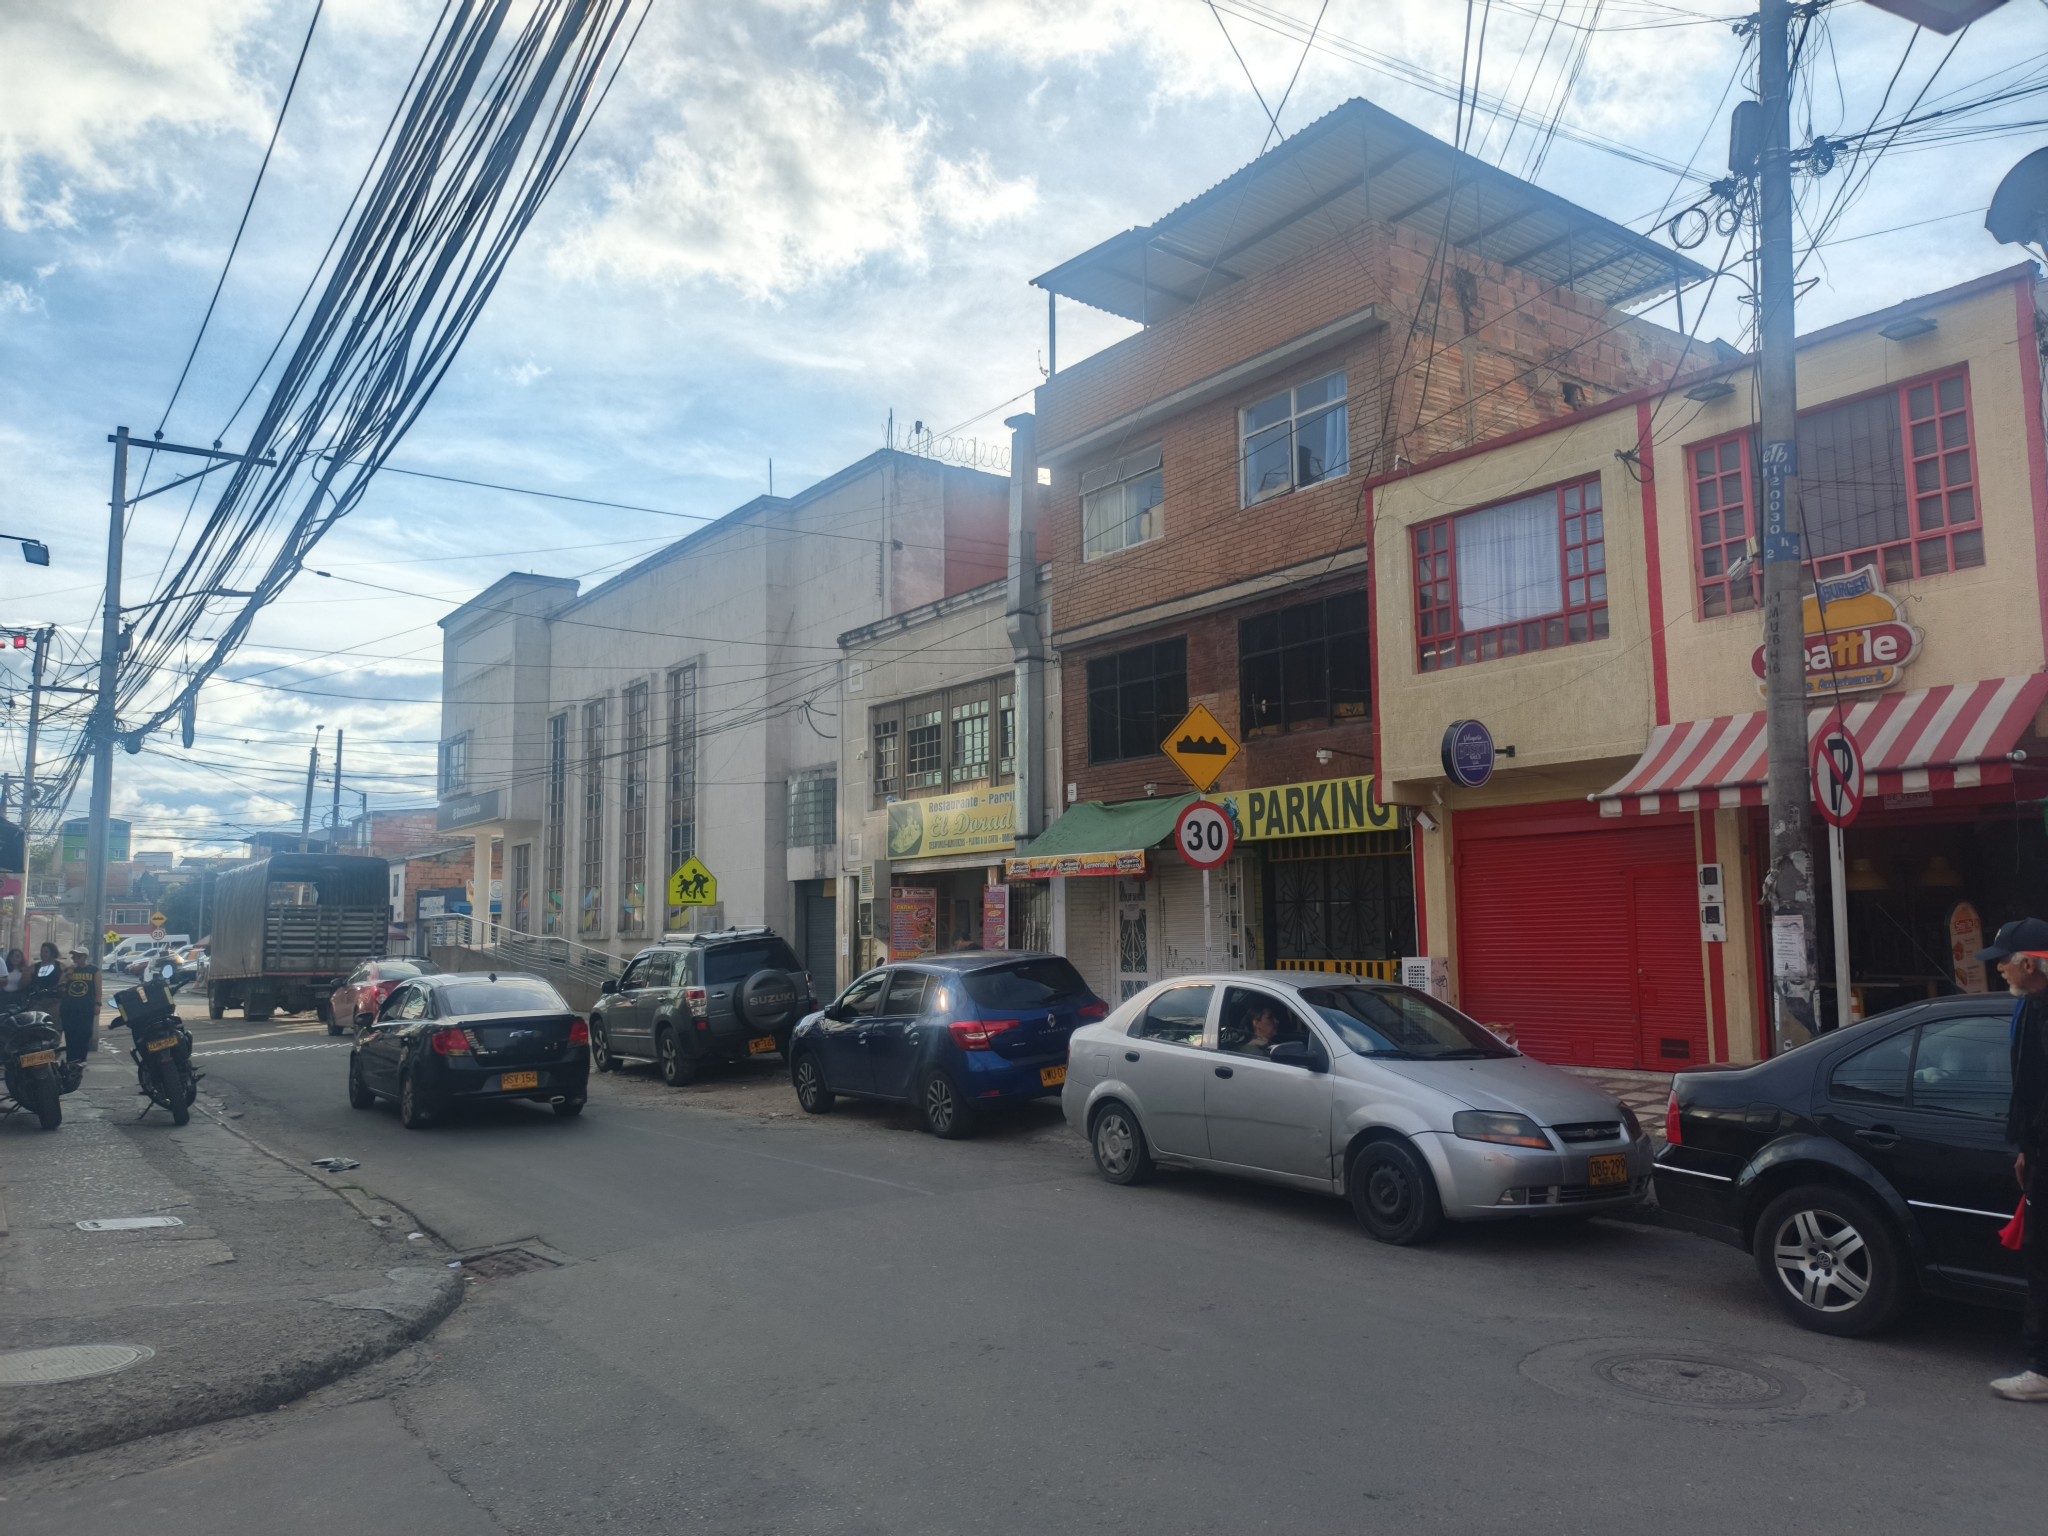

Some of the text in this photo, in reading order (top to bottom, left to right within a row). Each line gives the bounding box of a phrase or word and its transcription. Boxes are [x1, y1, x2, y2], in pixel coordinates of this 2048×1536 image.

[1822, 576, 1870, 600] BURGER
[929, 797, 978, 812] Restaurante
[1249, 778, 1390, 837] PARKING
[931, 805, 1016, 837] El Dorad
[1187, 820, 1224, 851] 30
[750, 992, 795, 1006] SUZUKI
